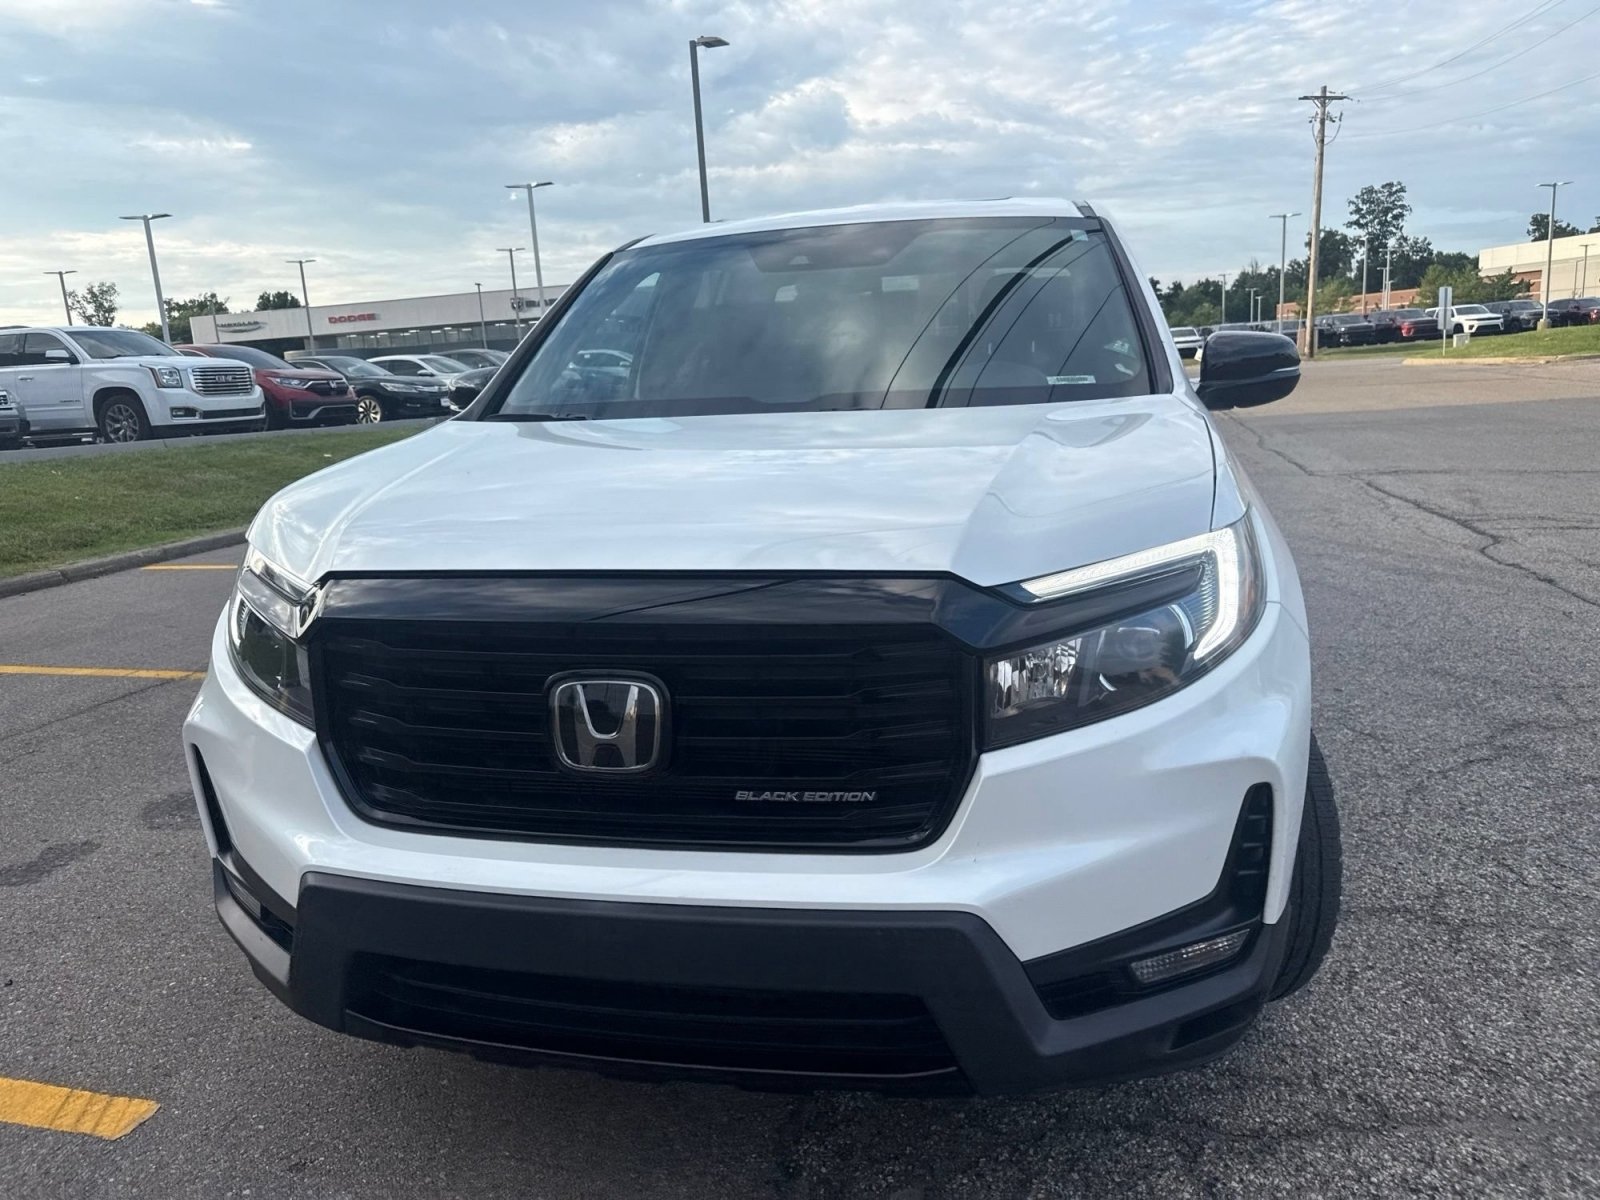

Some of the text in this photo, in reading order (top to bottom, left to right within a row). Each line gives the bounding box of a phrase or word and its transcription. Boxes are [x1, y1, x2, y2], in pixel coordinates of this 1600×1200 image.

[328, 313, 376, 323] DODGE
[735, 790, 876, 801] BLACK EDITION
